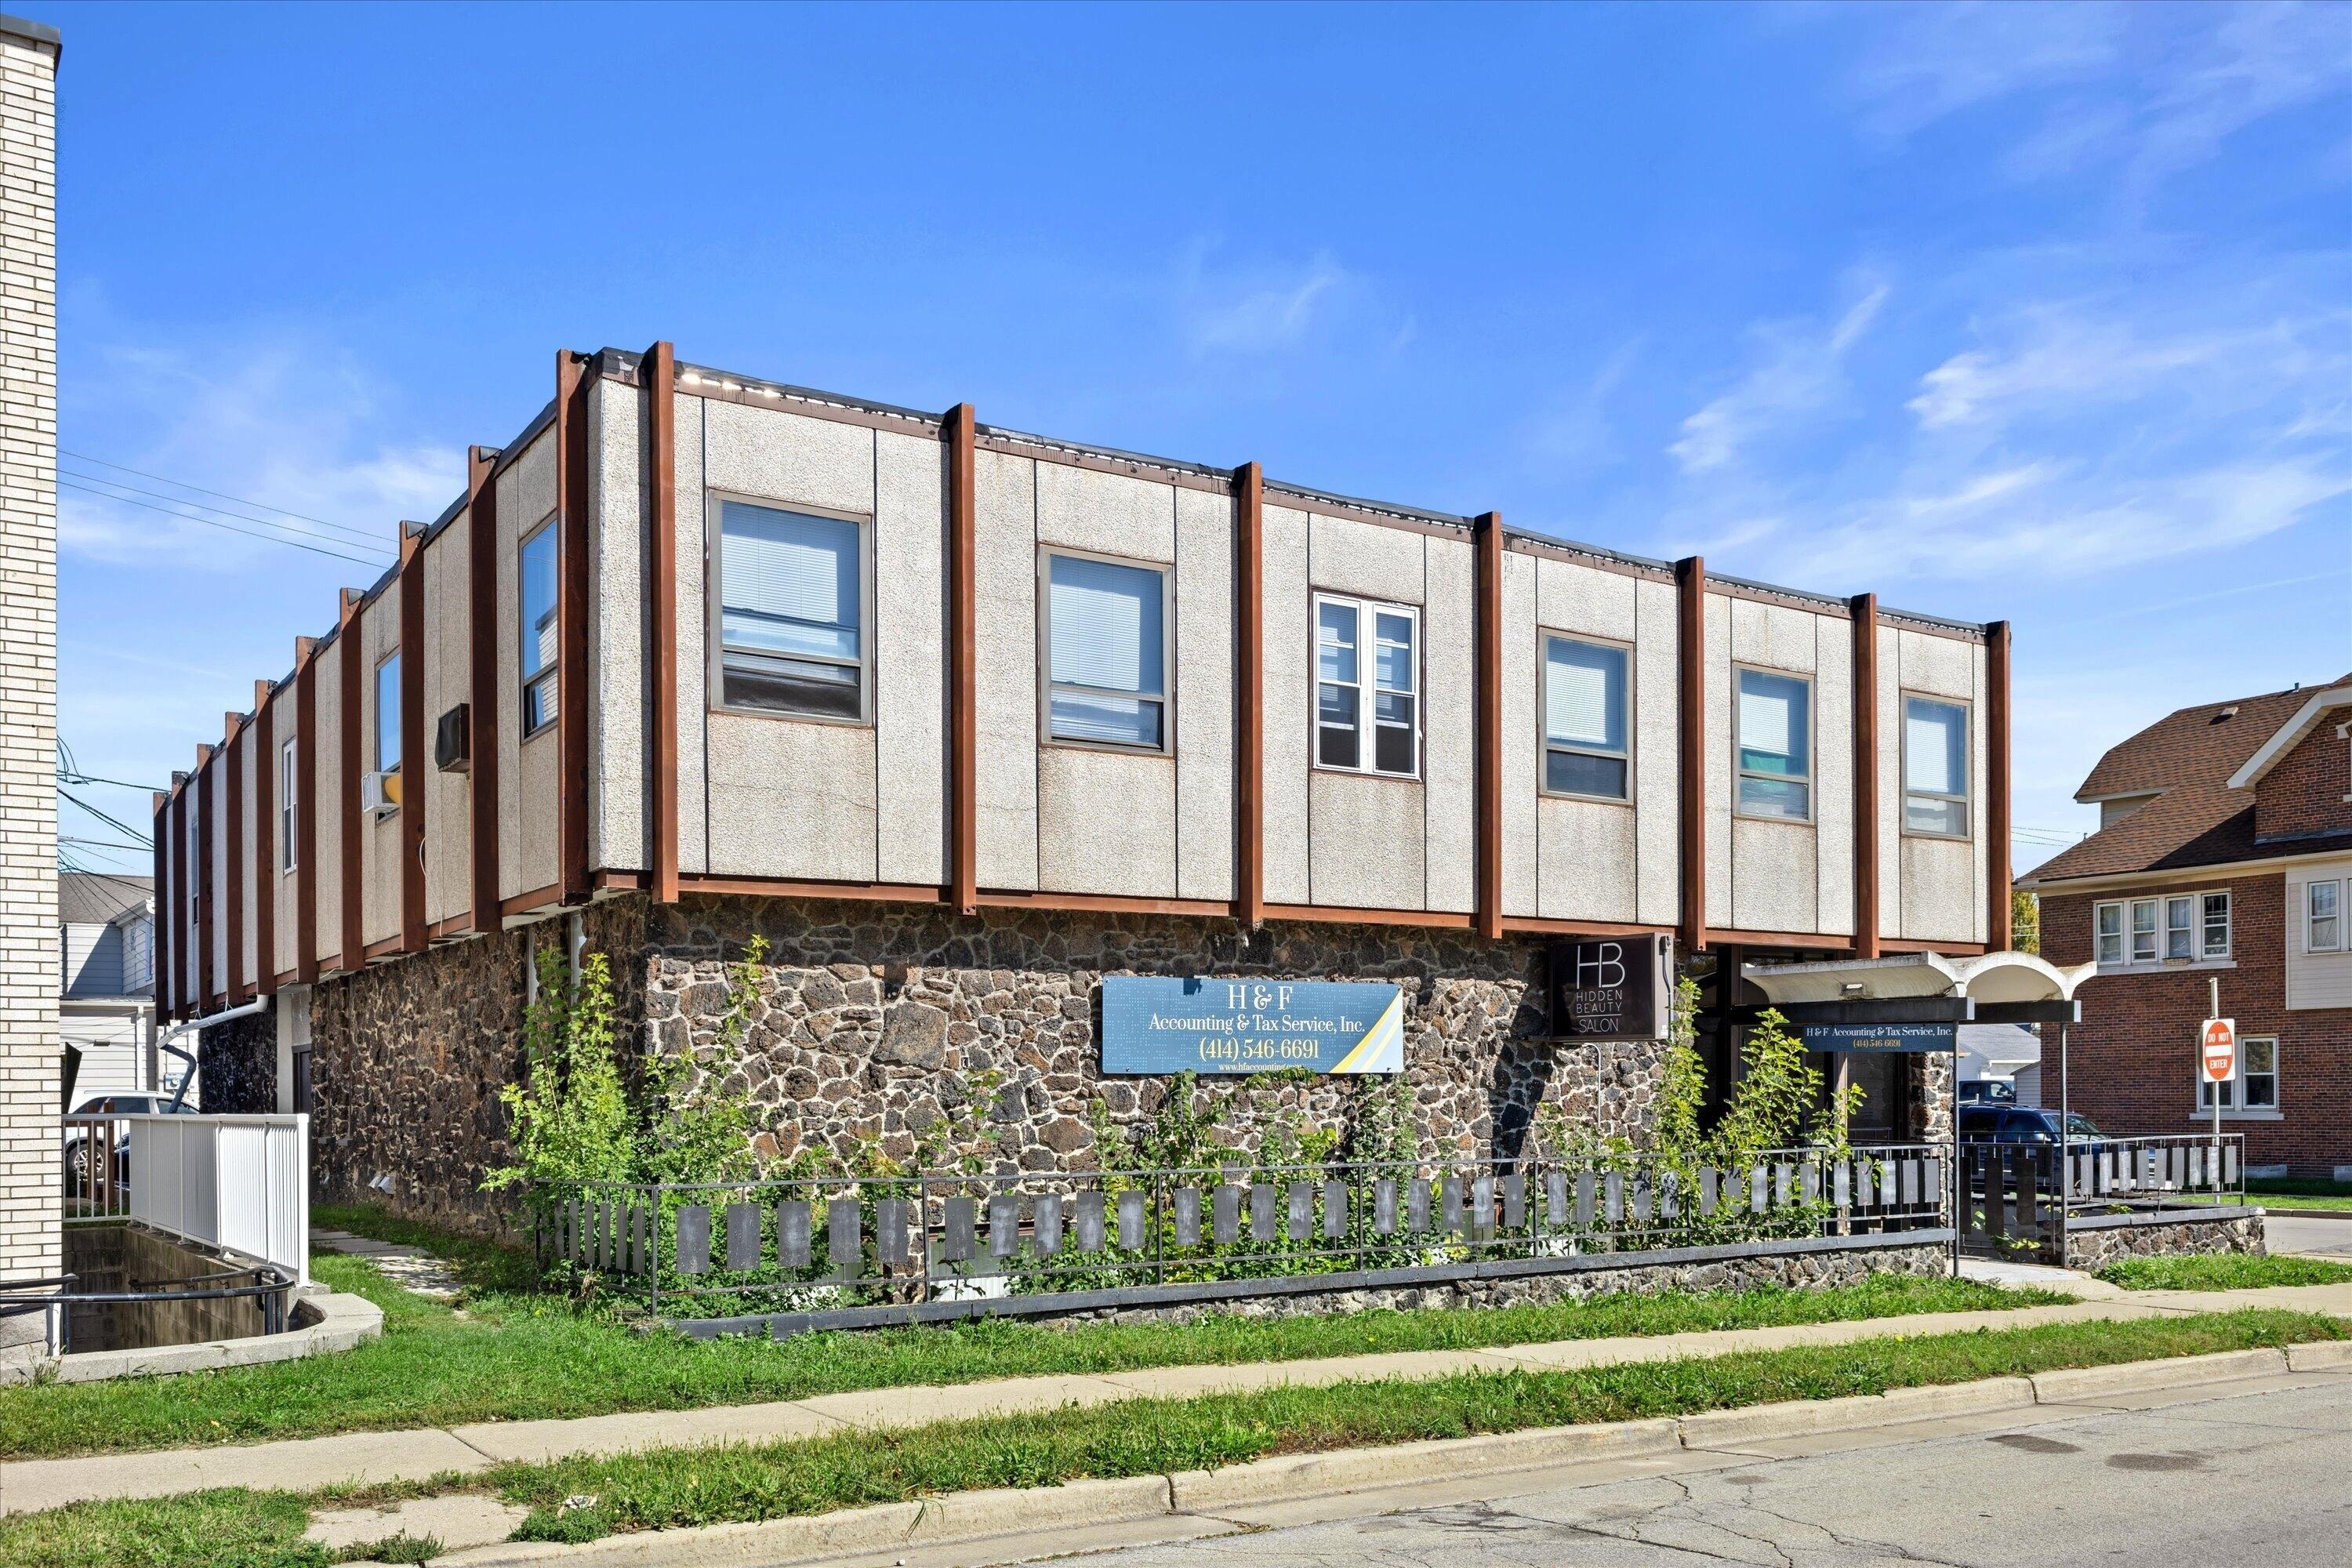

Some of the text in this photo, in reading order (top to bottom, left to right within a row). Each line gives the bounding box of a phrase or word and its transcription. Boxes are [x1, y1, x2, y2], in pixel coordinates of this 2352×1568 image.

[1577, 942, 1625, 989] HB
[1228, 985, 1293, 1011] H & F
[1576, 989, 1623, 1002] HIDDEN
[1576, 1002, 1622, 1014] BEAUTY
[1149, 1012, 1366, 1035] Accounting & Tax Service, Inc.
[1579, 1018, 1618, 1033] SALON
[1806, 1026, 1953, 1038] H & F Accounting & Tax Service, Inc.
[2208, 1032, 2230, 1043] DO NOT
[1200, 1037, 1319, 1062] (414) 546-6691
[1853, 1039, 1900, 1048] (414) 546-6691
[1218, 1062, 1302, 1072] www.hfaccounting
[2209, 1059, 2227, 1069] ENTER
